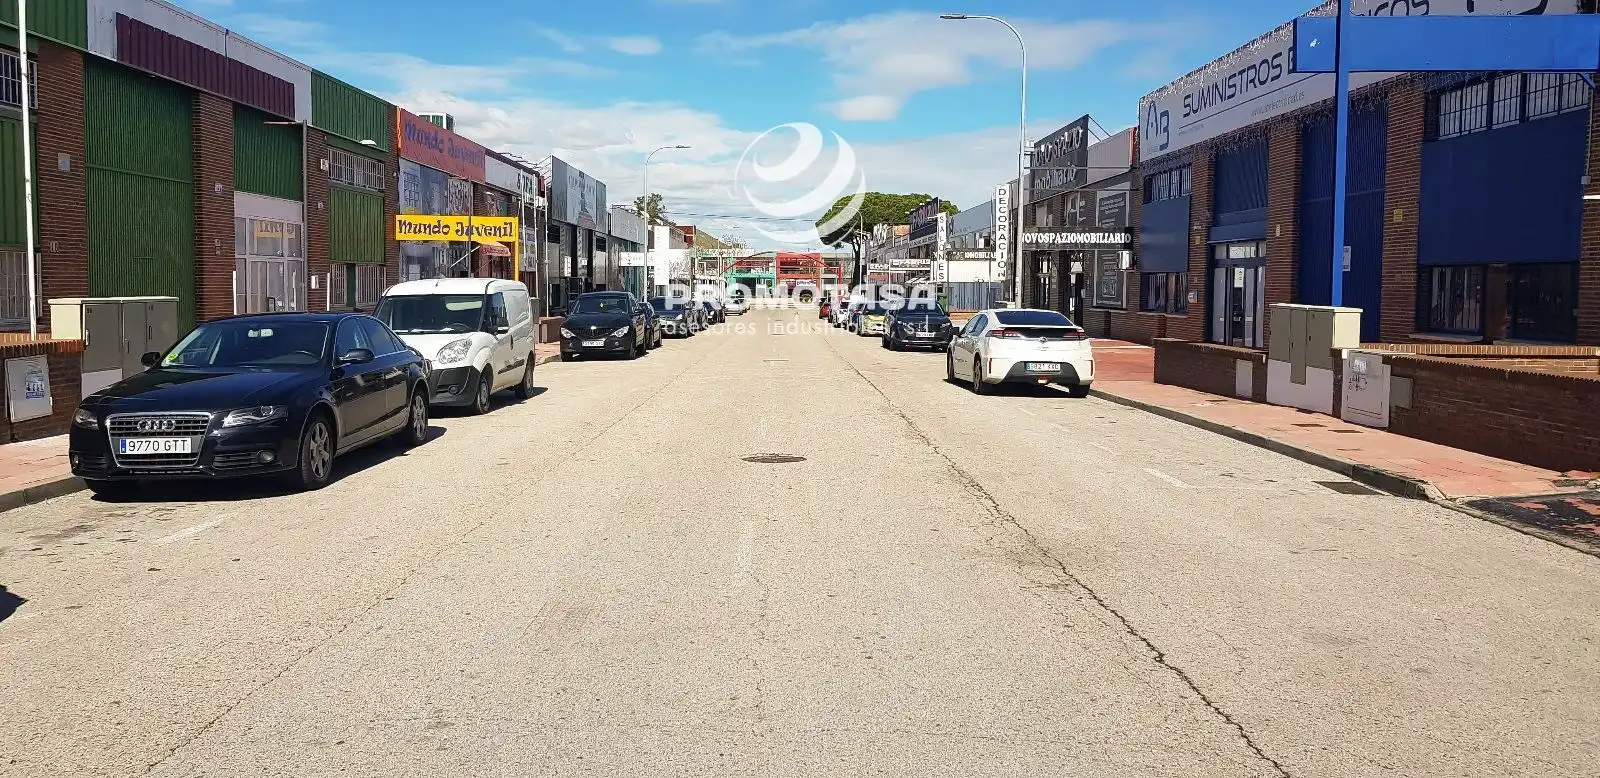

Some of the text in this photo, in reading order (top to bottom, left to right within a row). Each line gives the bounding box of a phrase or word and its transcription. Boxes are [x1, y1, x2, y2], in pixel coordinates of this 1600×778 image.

[1183, 52, 1282, 118] SUMINISTROS
[398, 219, 513, 238] Mundo Juvenil
[129, 439, 188, 452] 9770 GTT
